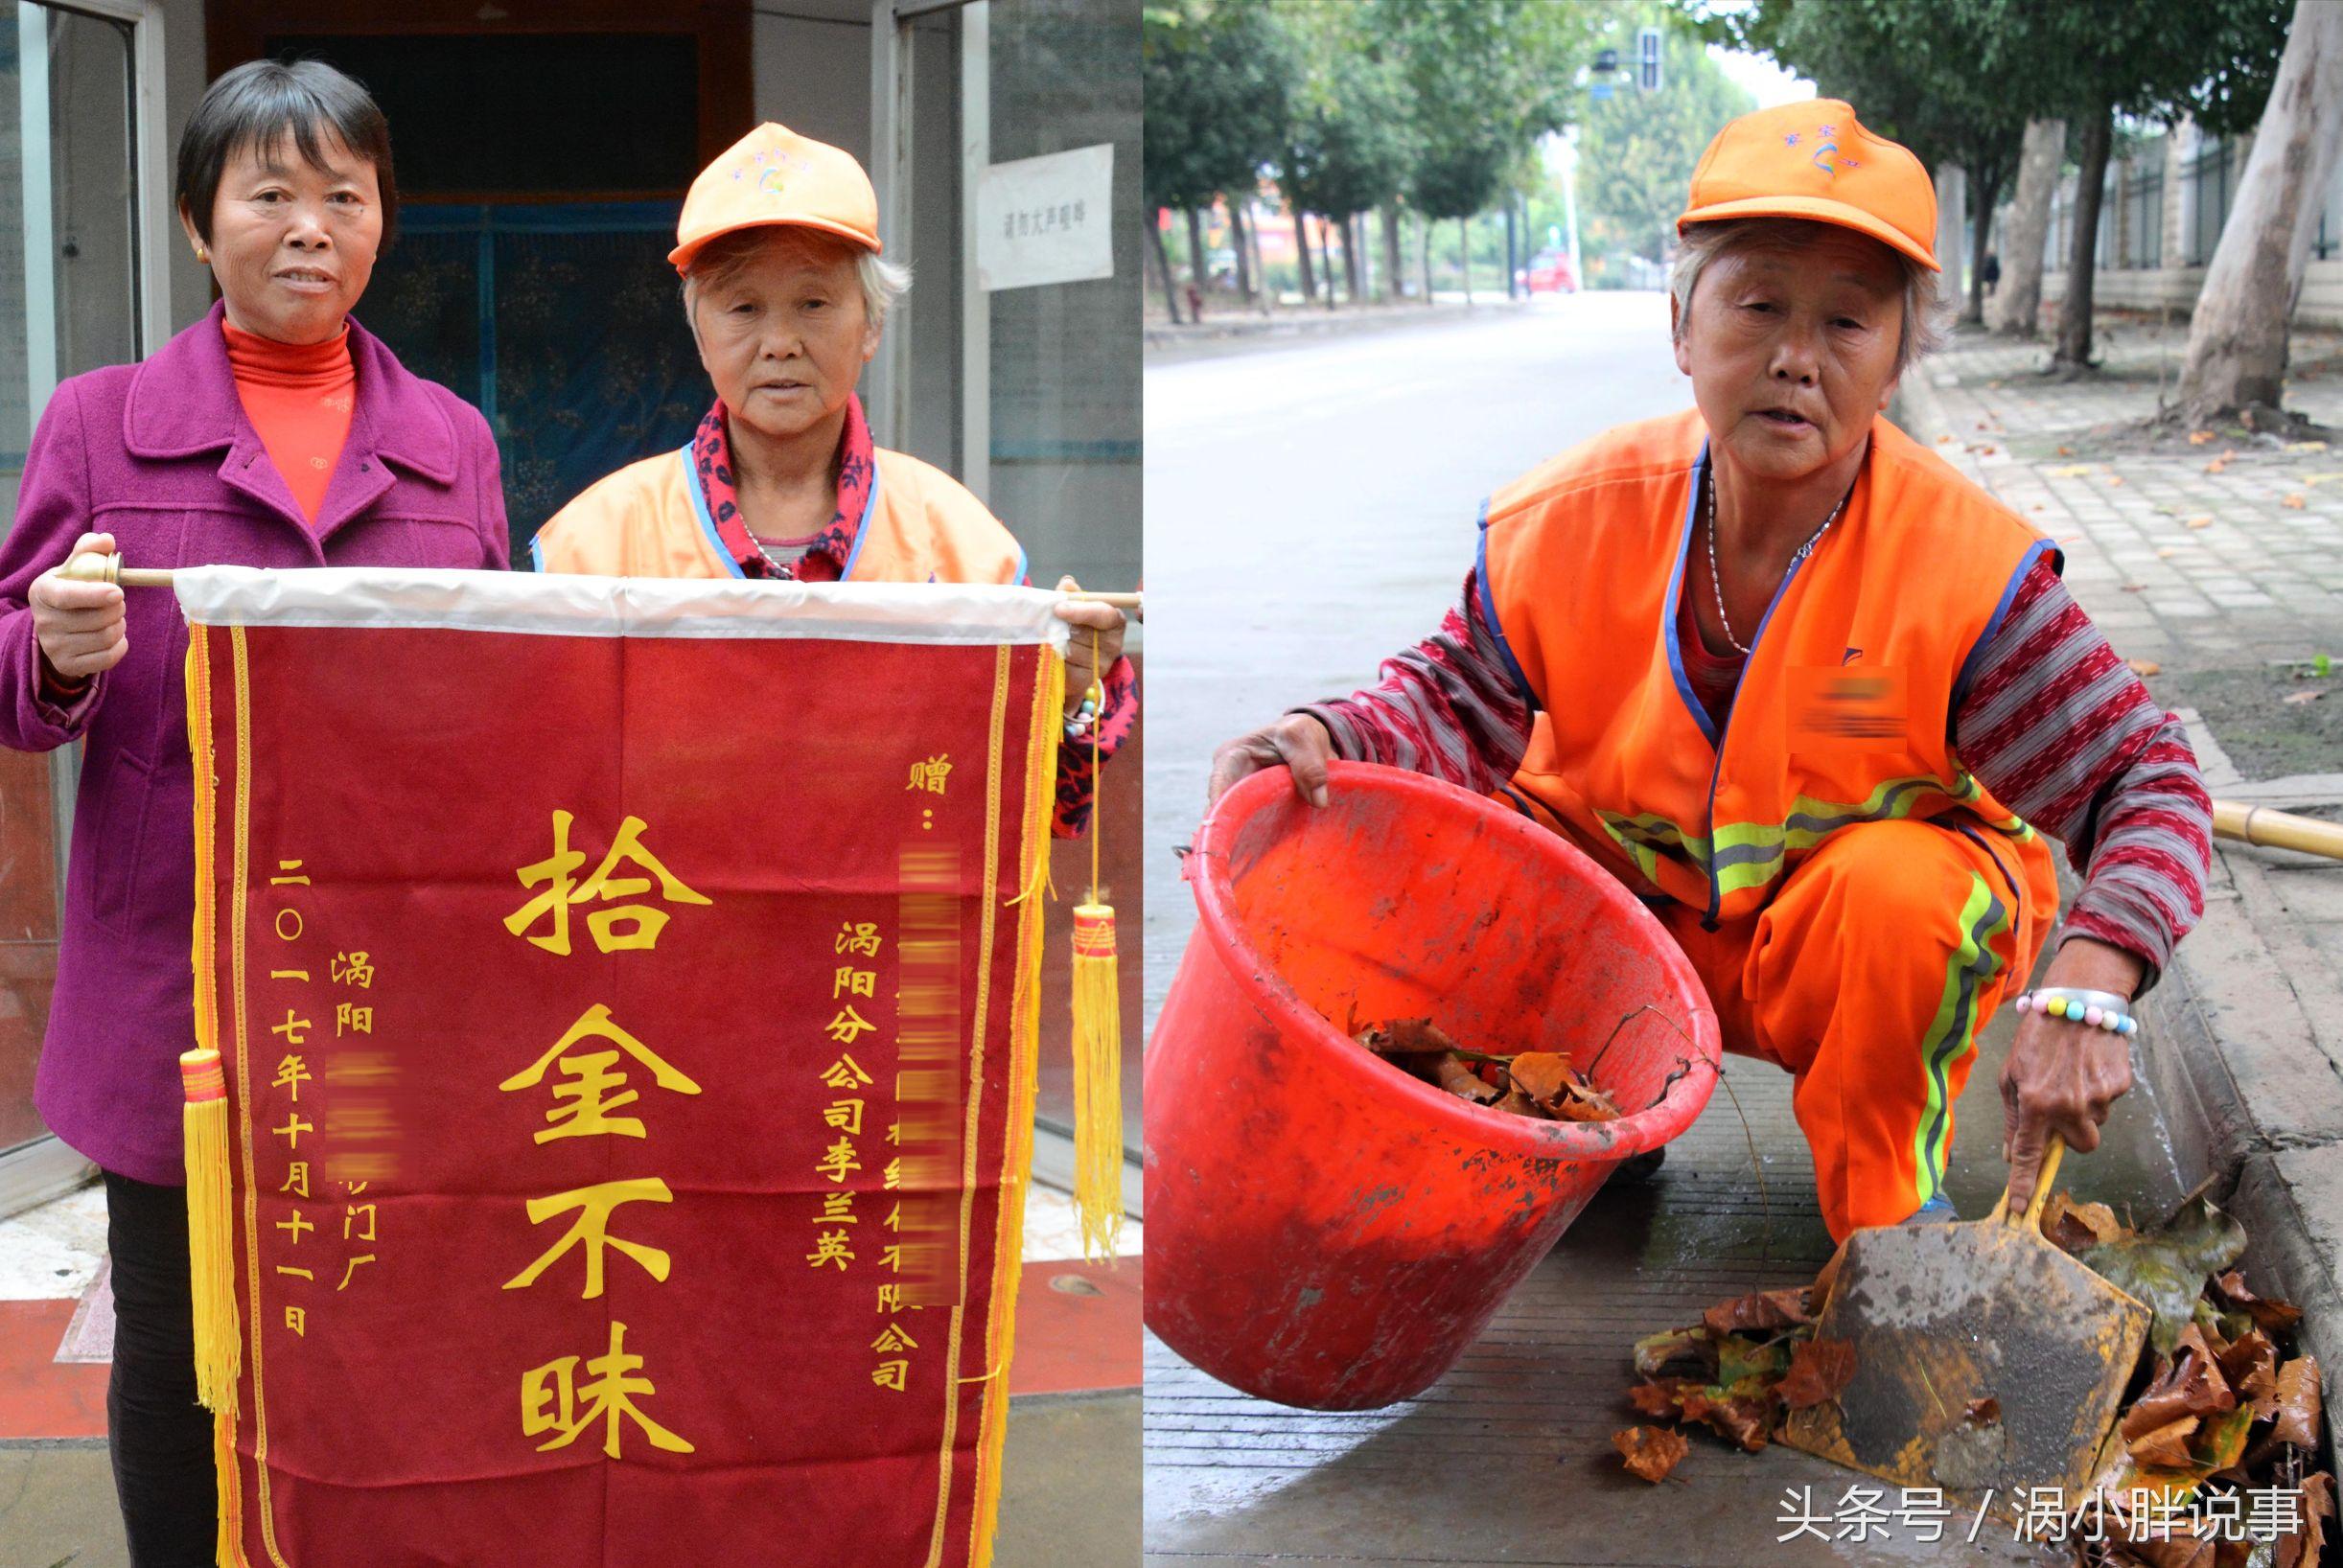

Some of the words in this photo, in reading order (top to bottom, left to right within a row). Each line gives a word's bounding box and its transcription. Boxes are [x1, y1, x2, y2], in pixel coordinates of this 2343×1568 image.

[499, 808, 714, 1460] 拾金不昧
[806, 921, 882, 1273] 涡阳分公司李兰英
